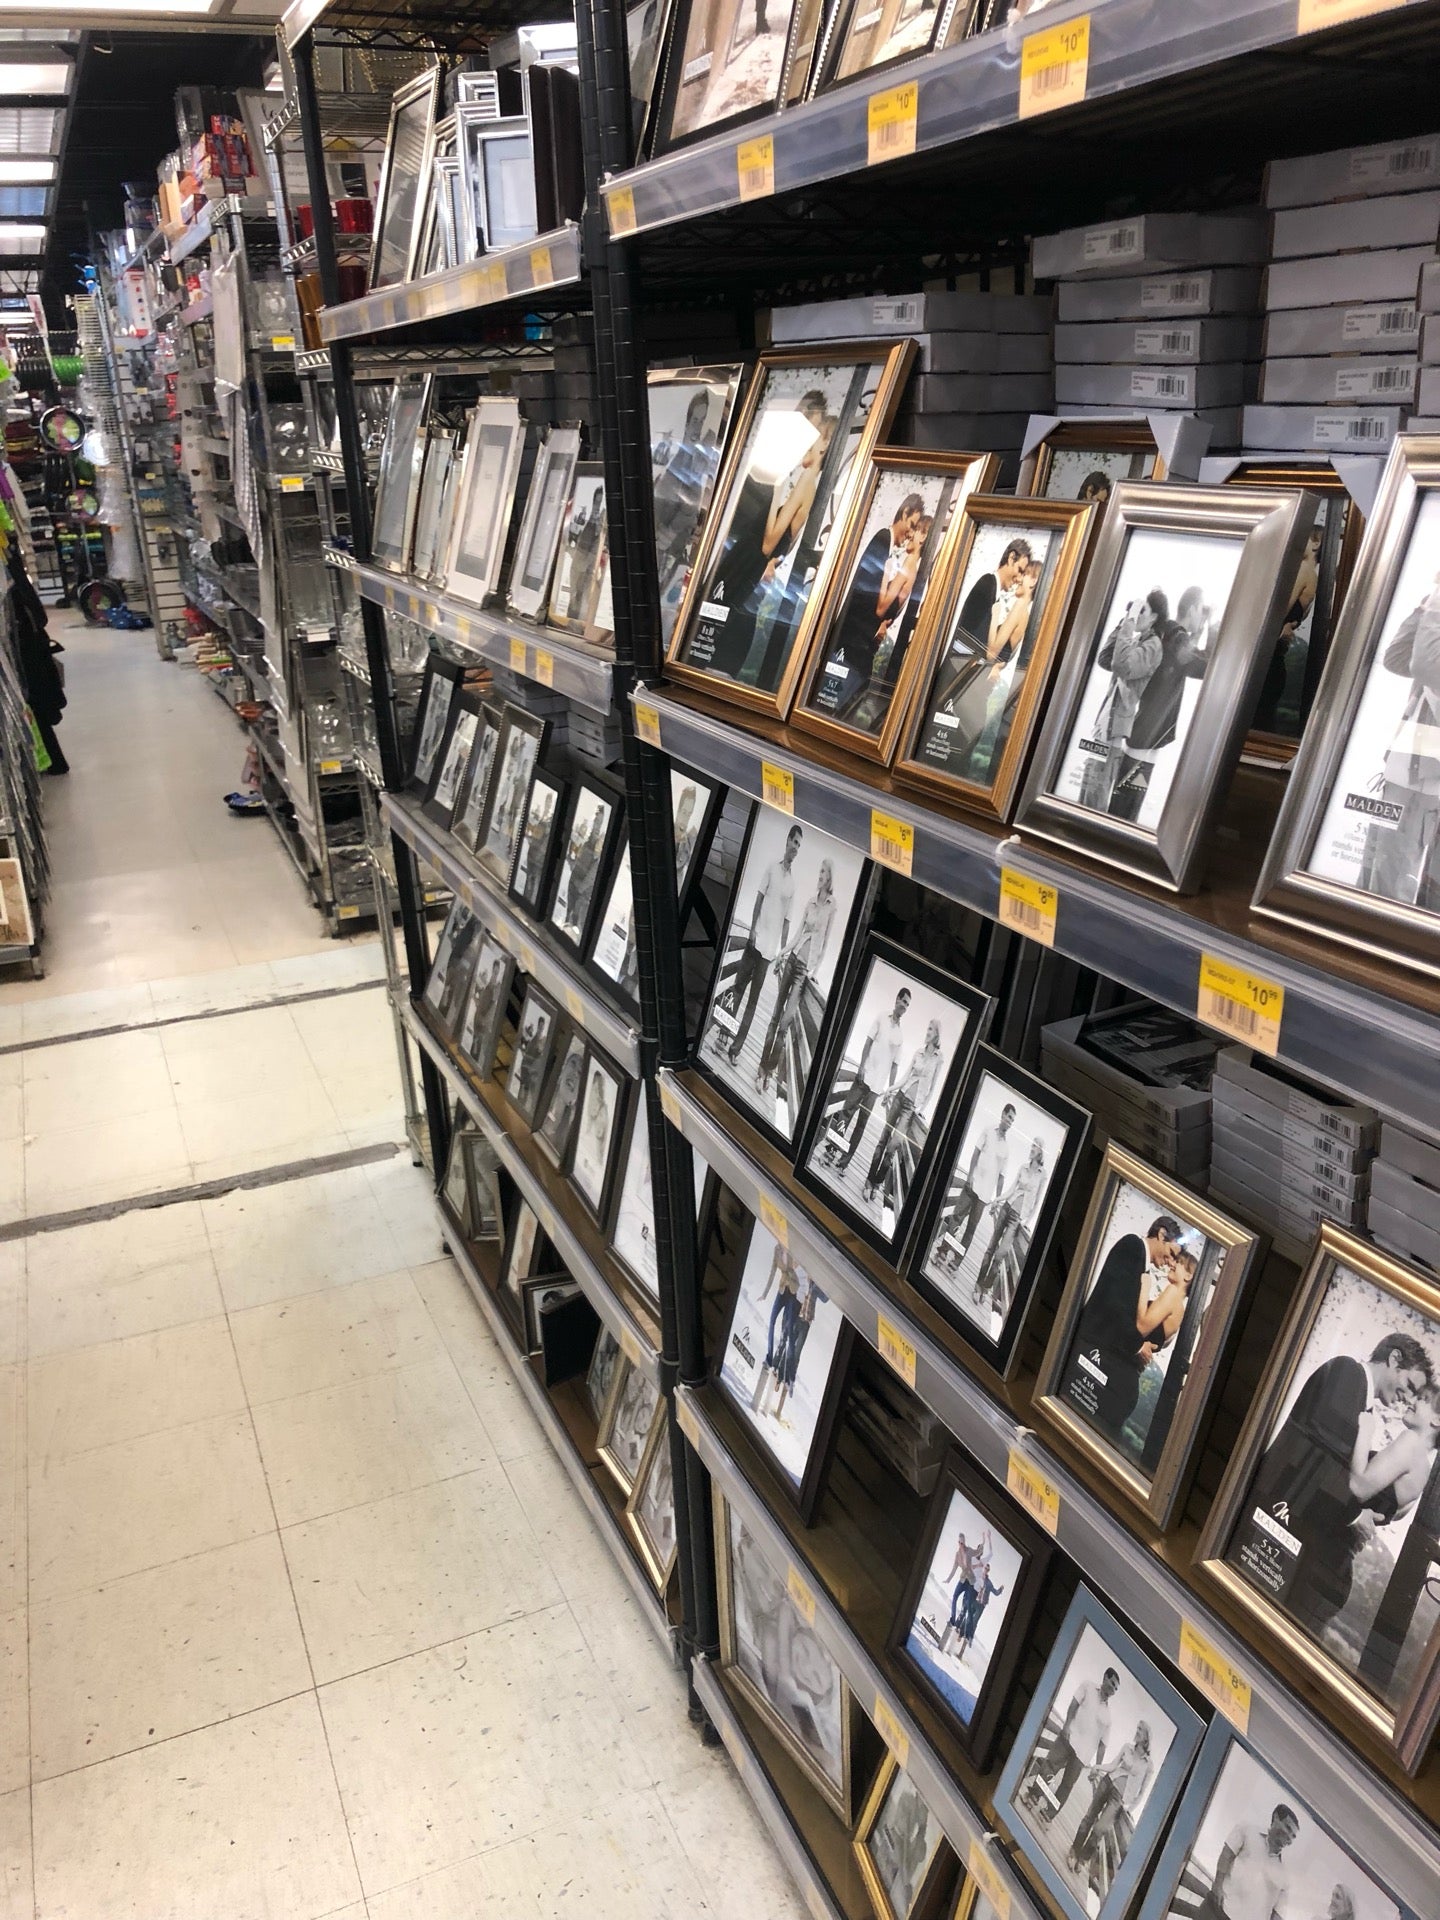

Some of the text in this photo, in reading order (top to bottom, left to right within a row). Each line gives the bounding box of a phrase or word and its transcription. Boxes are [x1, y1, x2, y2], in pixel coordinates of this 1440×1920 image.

[1080, 740, 1107, 755] MALDEN
[1346, 796, 1400, 820] MALDEN
[1255, 1510, 1300, 1552] MALDEN
[1241, 1545, 1285, 1586] stands vertically
[1247, 1558, 1280, 1592] horizontally
